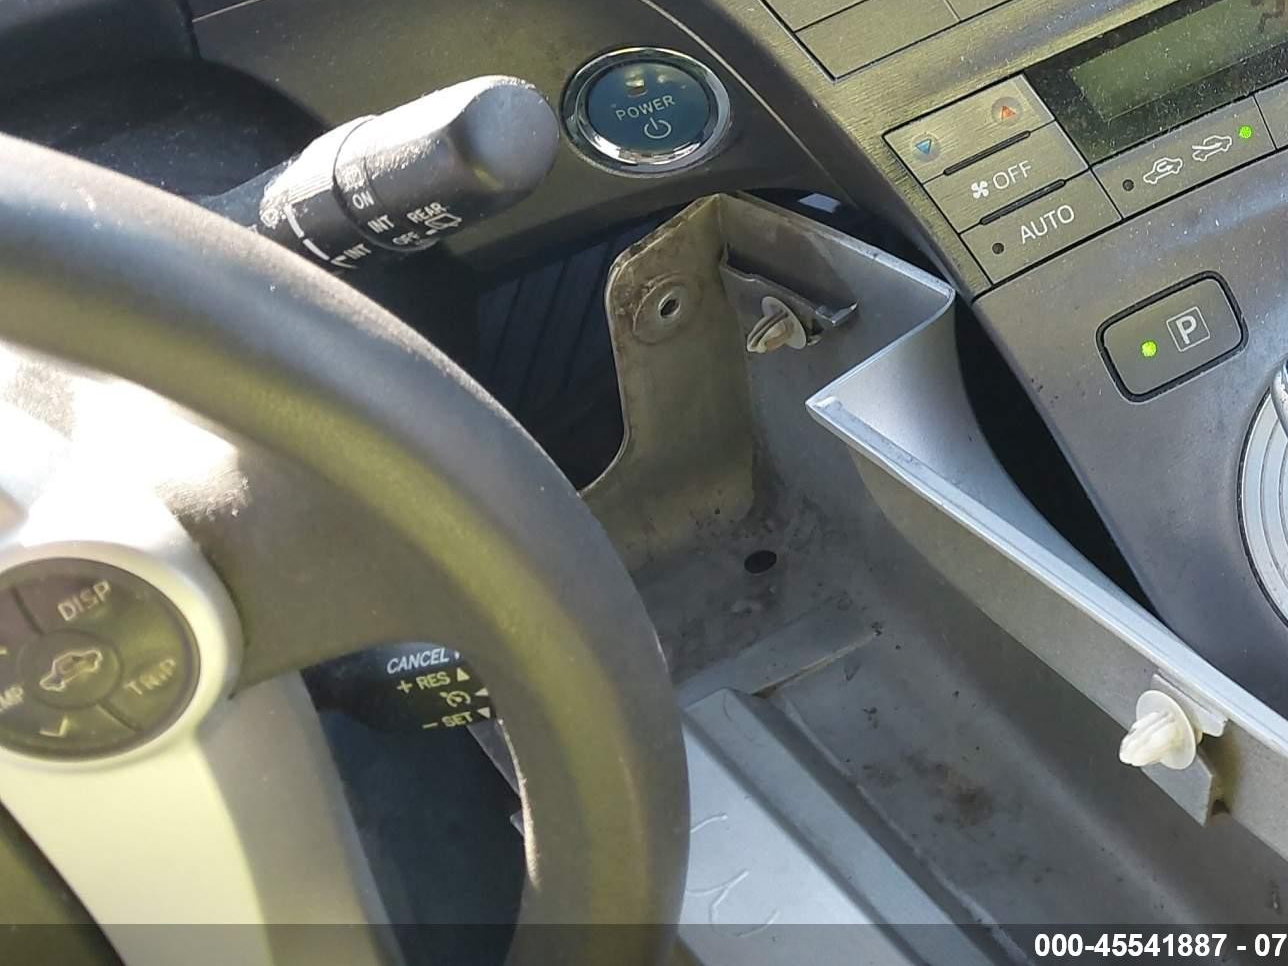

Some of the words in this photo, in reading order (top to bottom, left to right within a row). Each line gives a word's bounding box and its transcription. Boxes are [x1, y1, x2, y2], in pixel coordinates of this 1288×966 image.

[615, 94, 677, 121] POWER
[992, 159, 1034, 190] OFF
[352, 190, 375, 210] ON
[406, 201, 448, 224] REAR
[367, 214, 397, 234] INT
[1019, 205, 1076, 244] AUTO
[342, 242, 373, 261] INT
[1175, 315, 1198, 345] P
[57, 580, 111, 621] DISP
[387, 647, 450, 675] CANCEL
[415, 671, 452, 690] RES
[441, 711, 473, 728] SET
